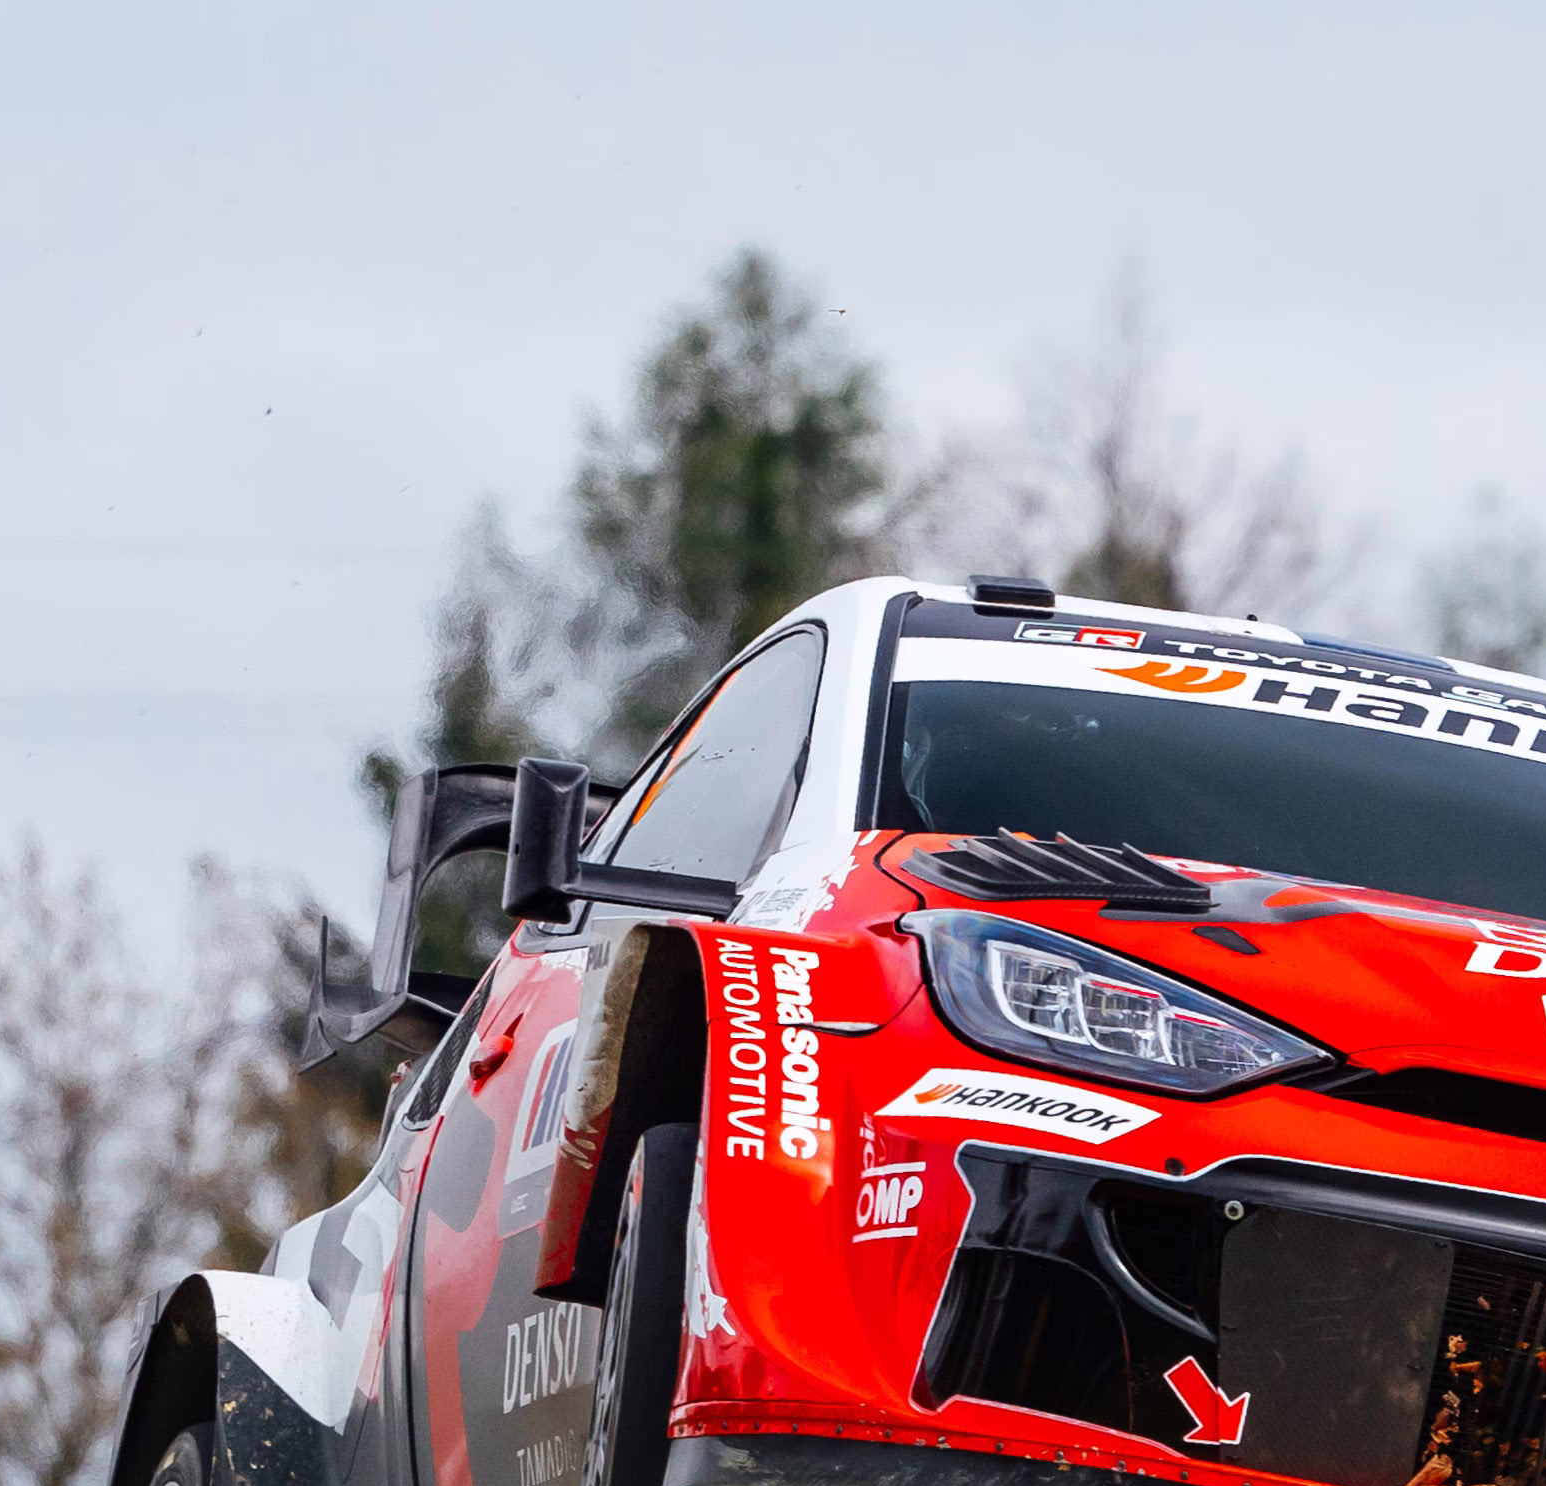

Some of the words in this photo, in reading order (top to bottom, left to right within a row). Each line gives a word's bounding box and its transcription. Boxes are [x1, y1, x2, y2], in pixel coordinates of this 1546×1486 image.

[1021, 626, 1138, 649] GR
[1163, 639, 1433, 690] TOYOTA
[715, 937, 767, 1162] AUTOMOTIVE
[769, 945, 834, 1161] Panasonic
[855, 1175, 924, 1228] OMP
[502, 1301, 583, 1415] DENSO
